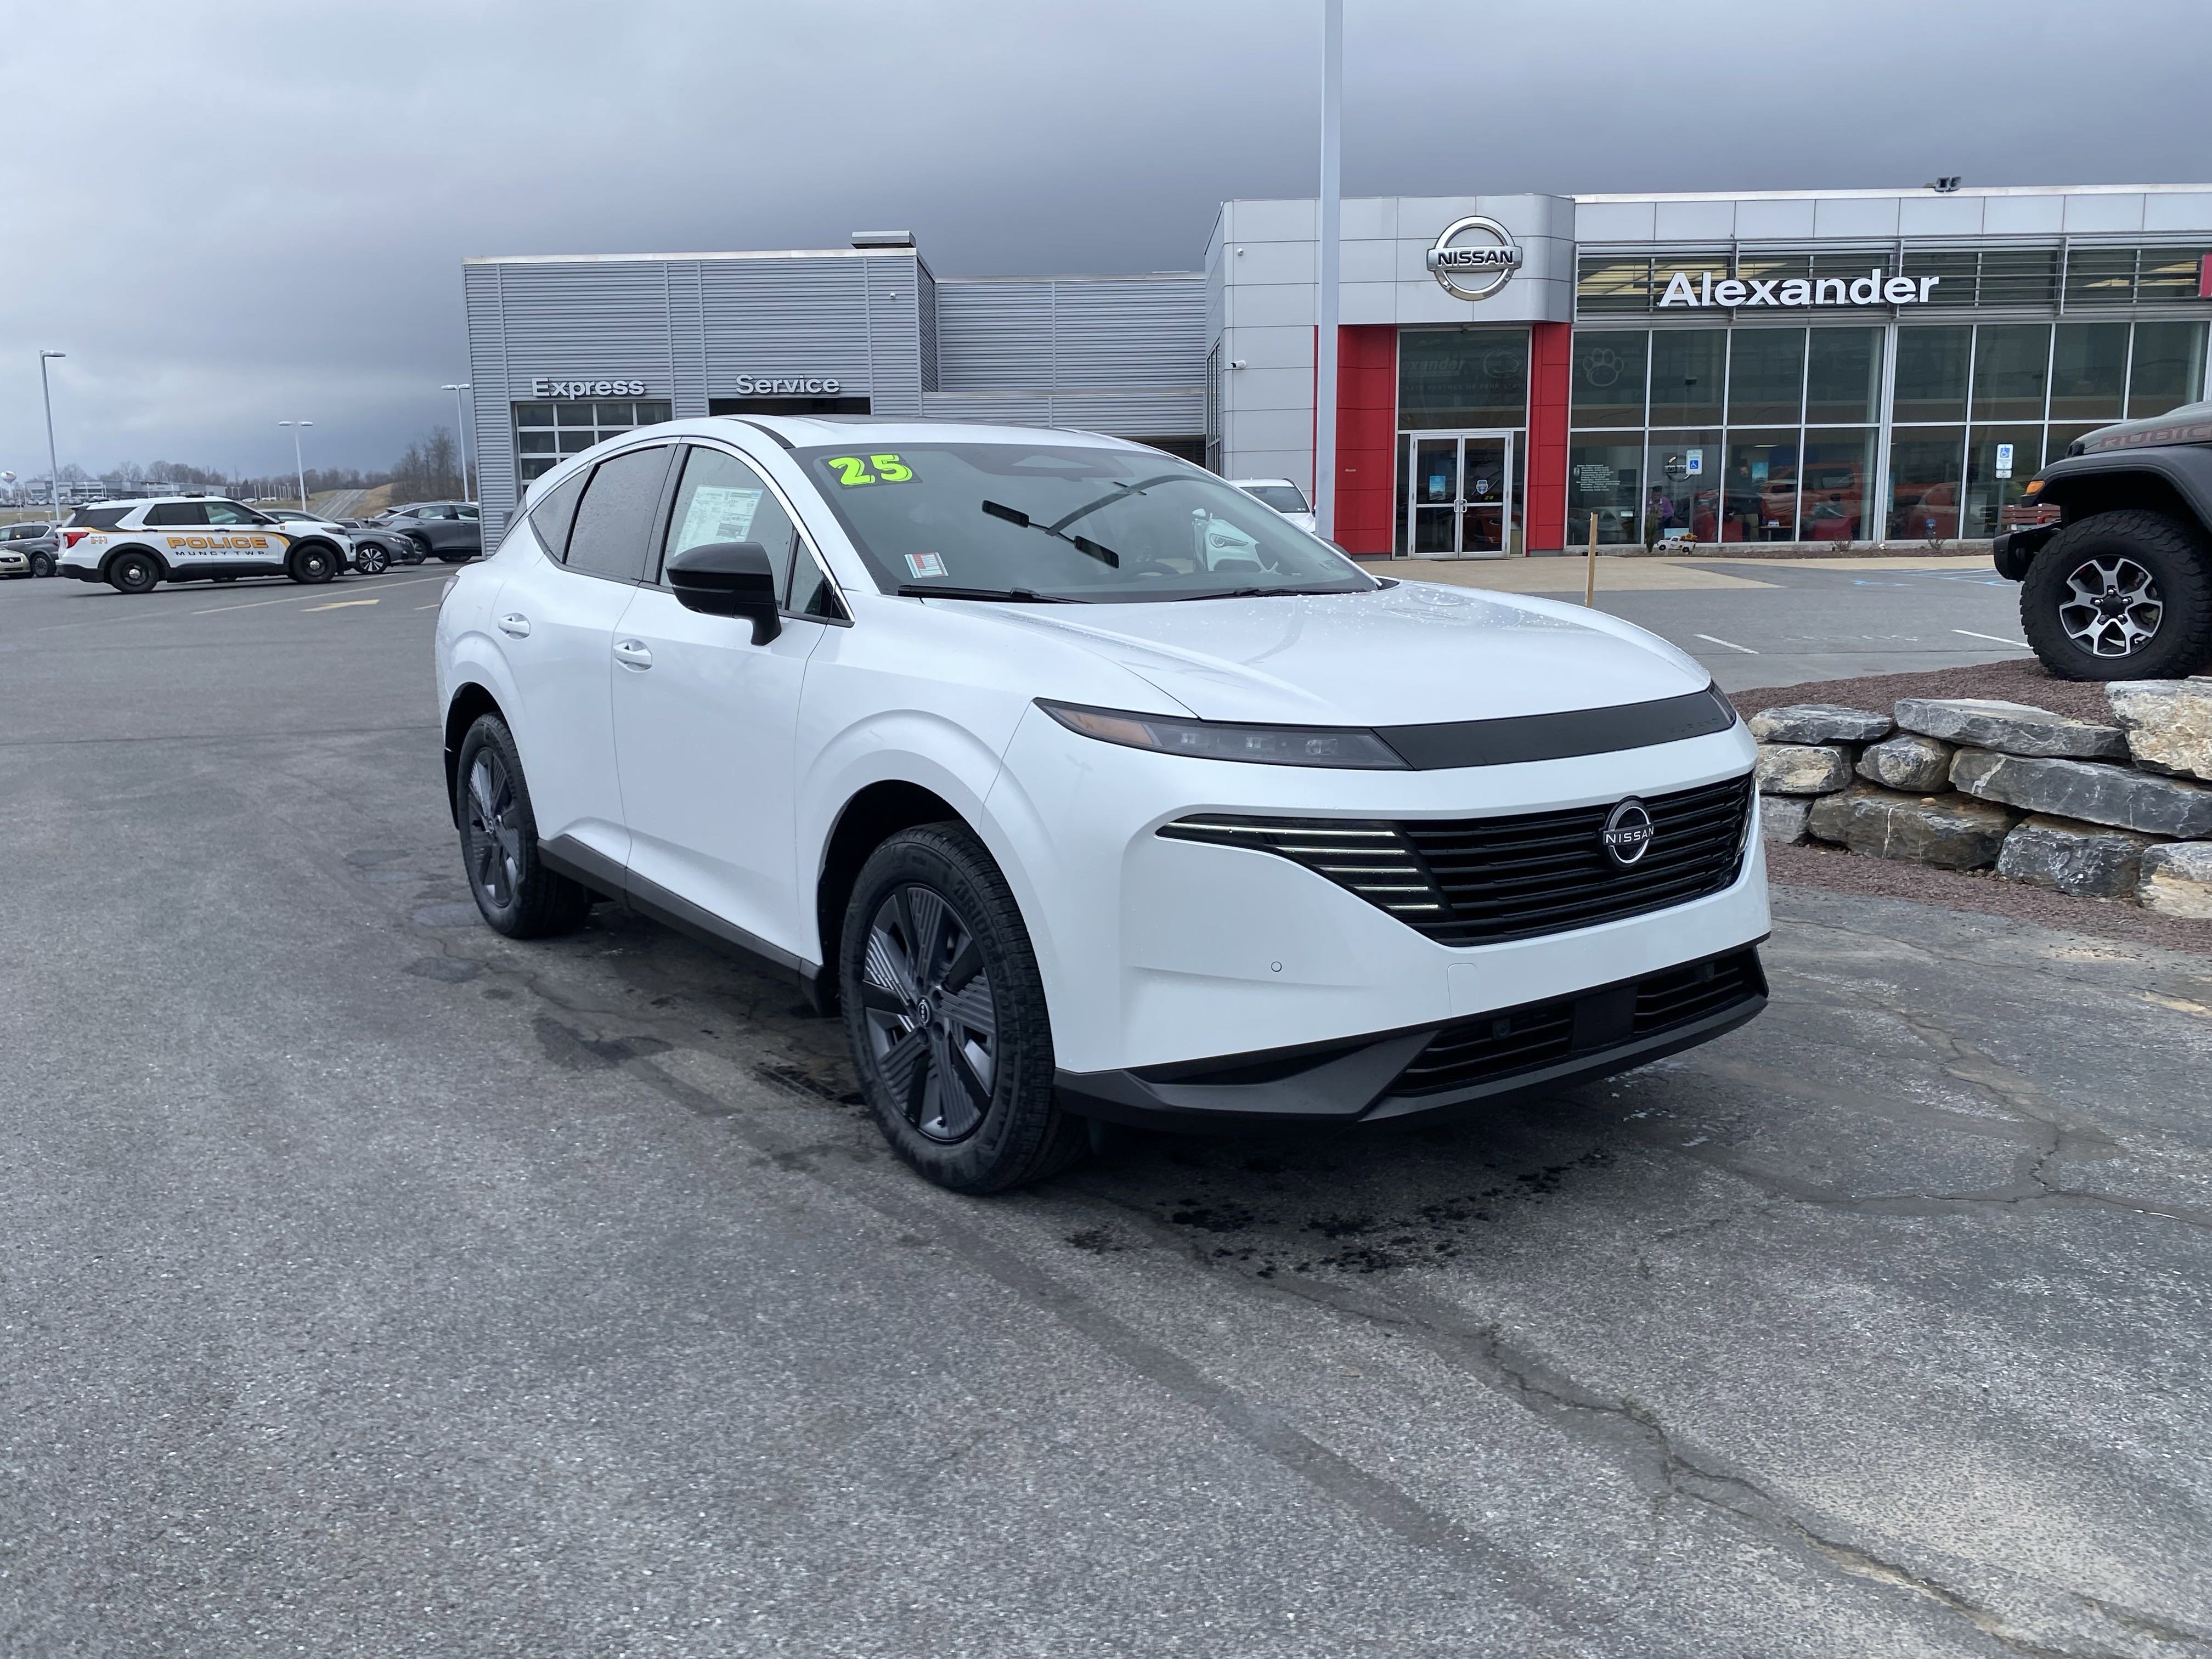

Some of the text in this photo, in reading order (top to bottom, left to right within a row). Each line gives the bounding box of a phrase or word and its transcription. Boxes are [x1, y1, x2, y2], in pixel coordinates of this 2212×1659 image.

[1437, 250, 1514, 266] NISSAN
[1658, 268, 1939, 307] Alexander
[532, 378, 645, 400] Express
[736, 374, 840, 394] Service
[2099, 422, 2212, 448] RUBIC
[828, 453, 913, 485] 25
[167, 537, 269, 549] POLICE
[1606, 826, 1654, 843] NISSAN
